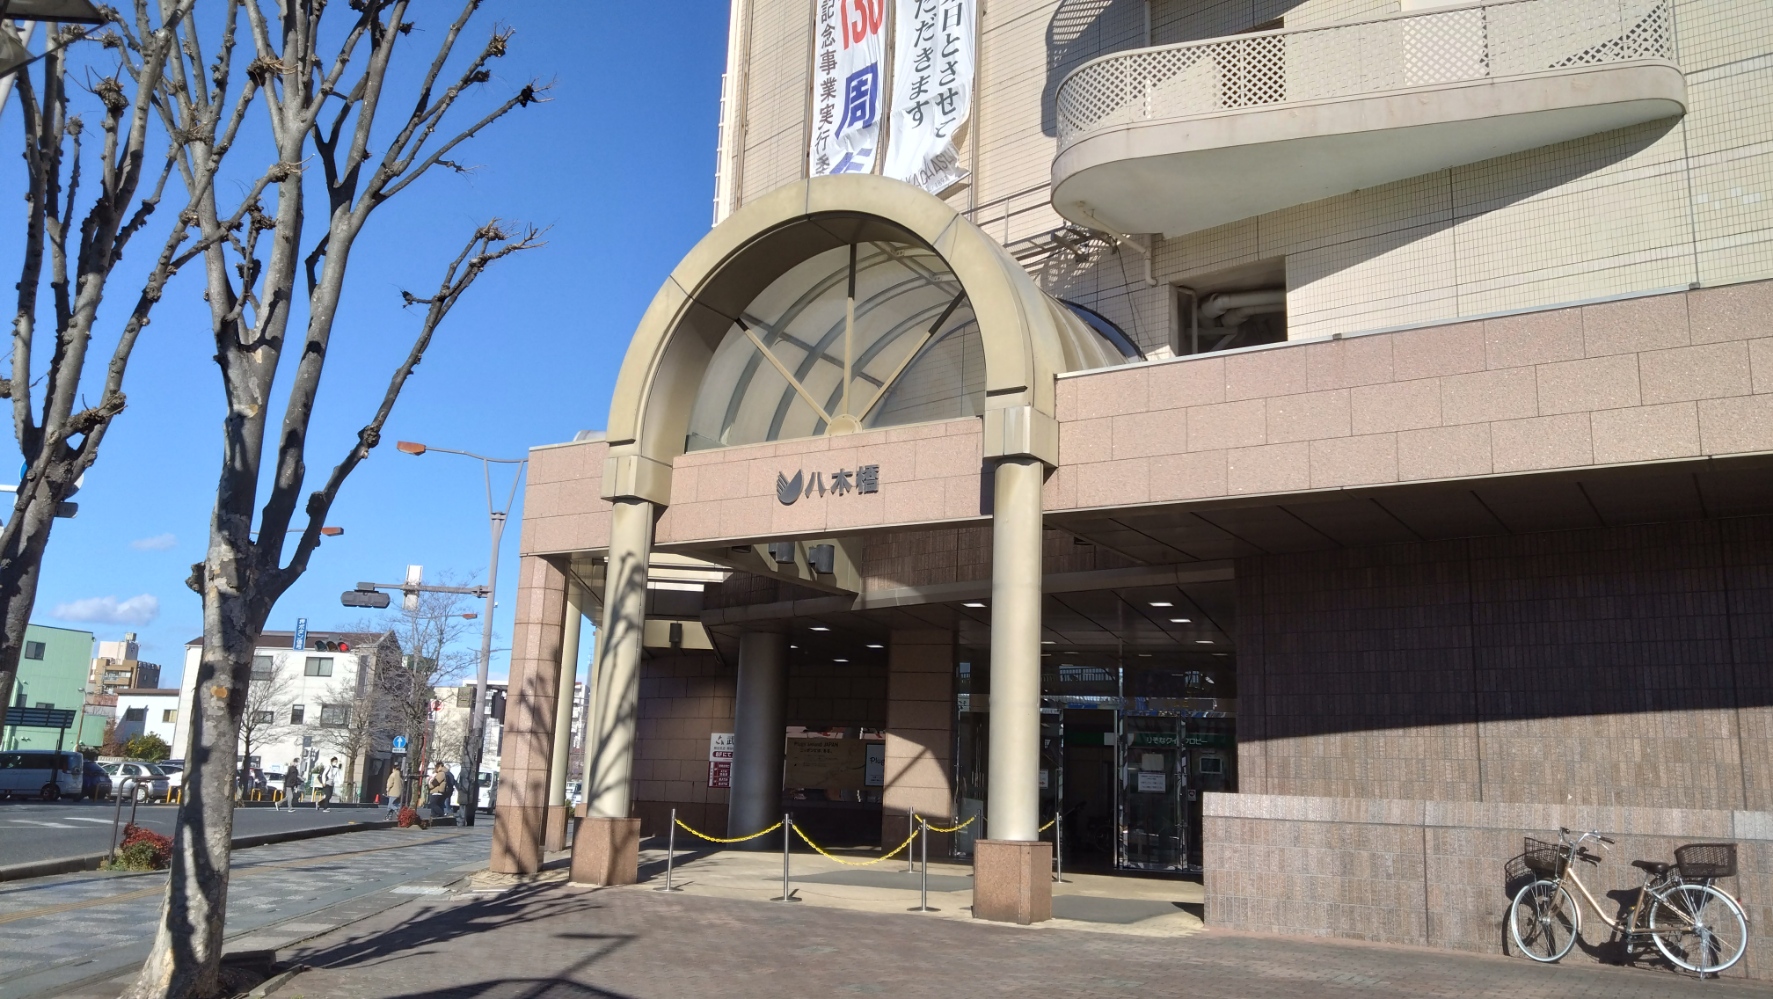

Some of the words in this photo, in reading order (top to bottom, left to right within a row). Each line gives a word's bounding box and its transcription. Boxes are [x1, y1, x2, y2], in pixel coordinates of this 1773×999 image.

[935, 0, 963, 138] 日とさせて
